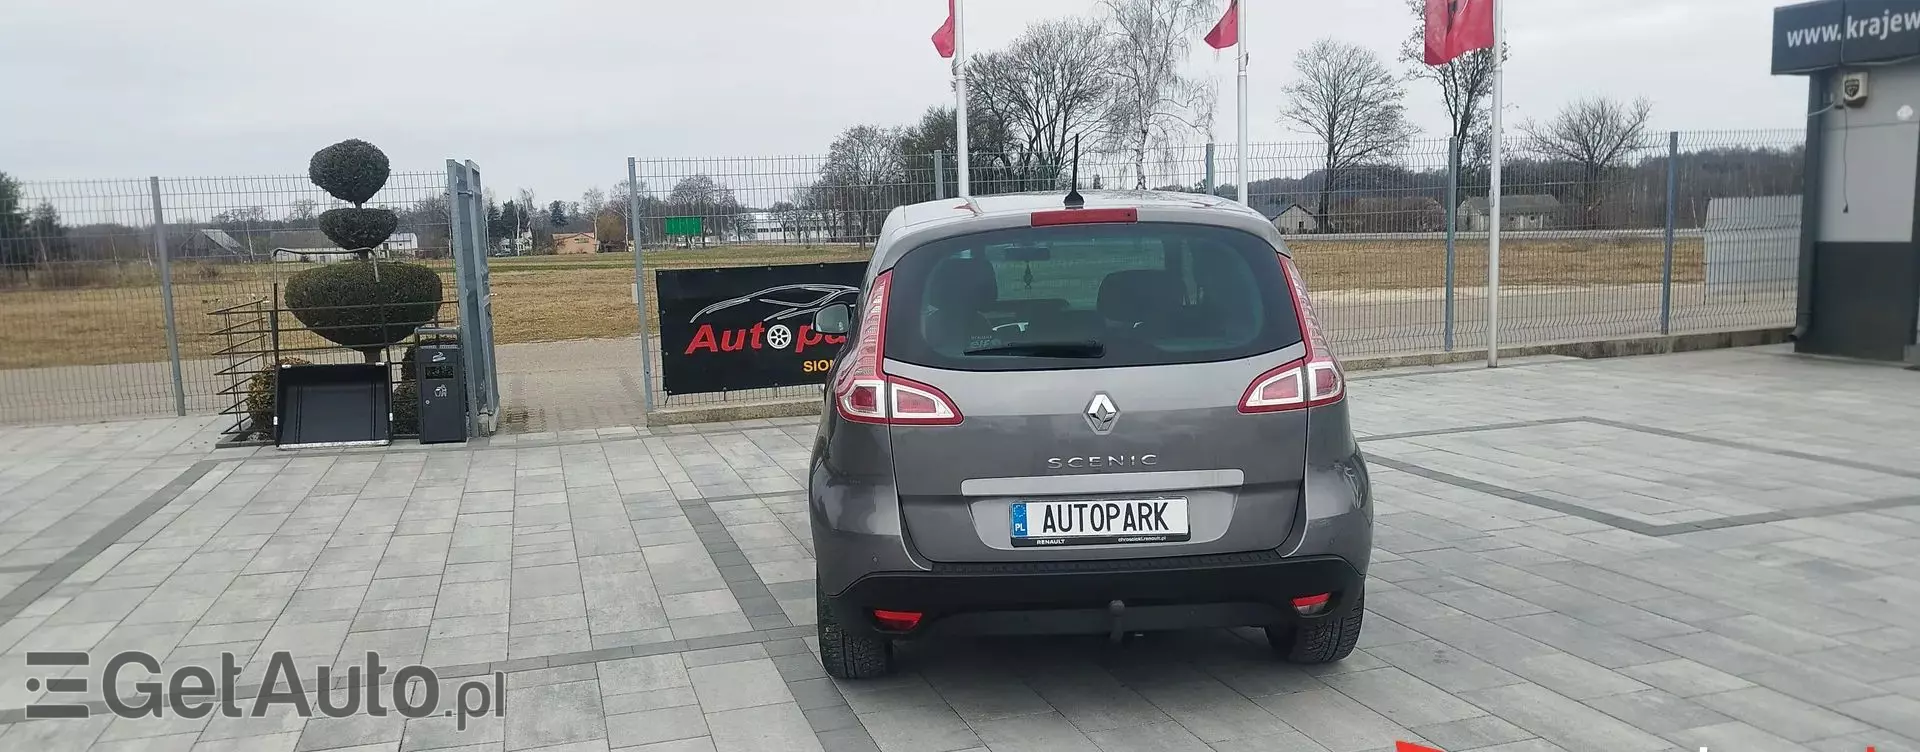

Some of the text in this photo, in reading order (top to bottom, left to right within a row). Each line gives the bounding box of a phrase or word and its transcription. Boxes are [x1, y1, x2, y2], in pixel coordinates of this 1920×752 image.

[1047, 454, 1158, 469] SCENIC
[1042, 502, 1170, 533] AUTOPARK
[1015, 523, 1026, 533] PL
